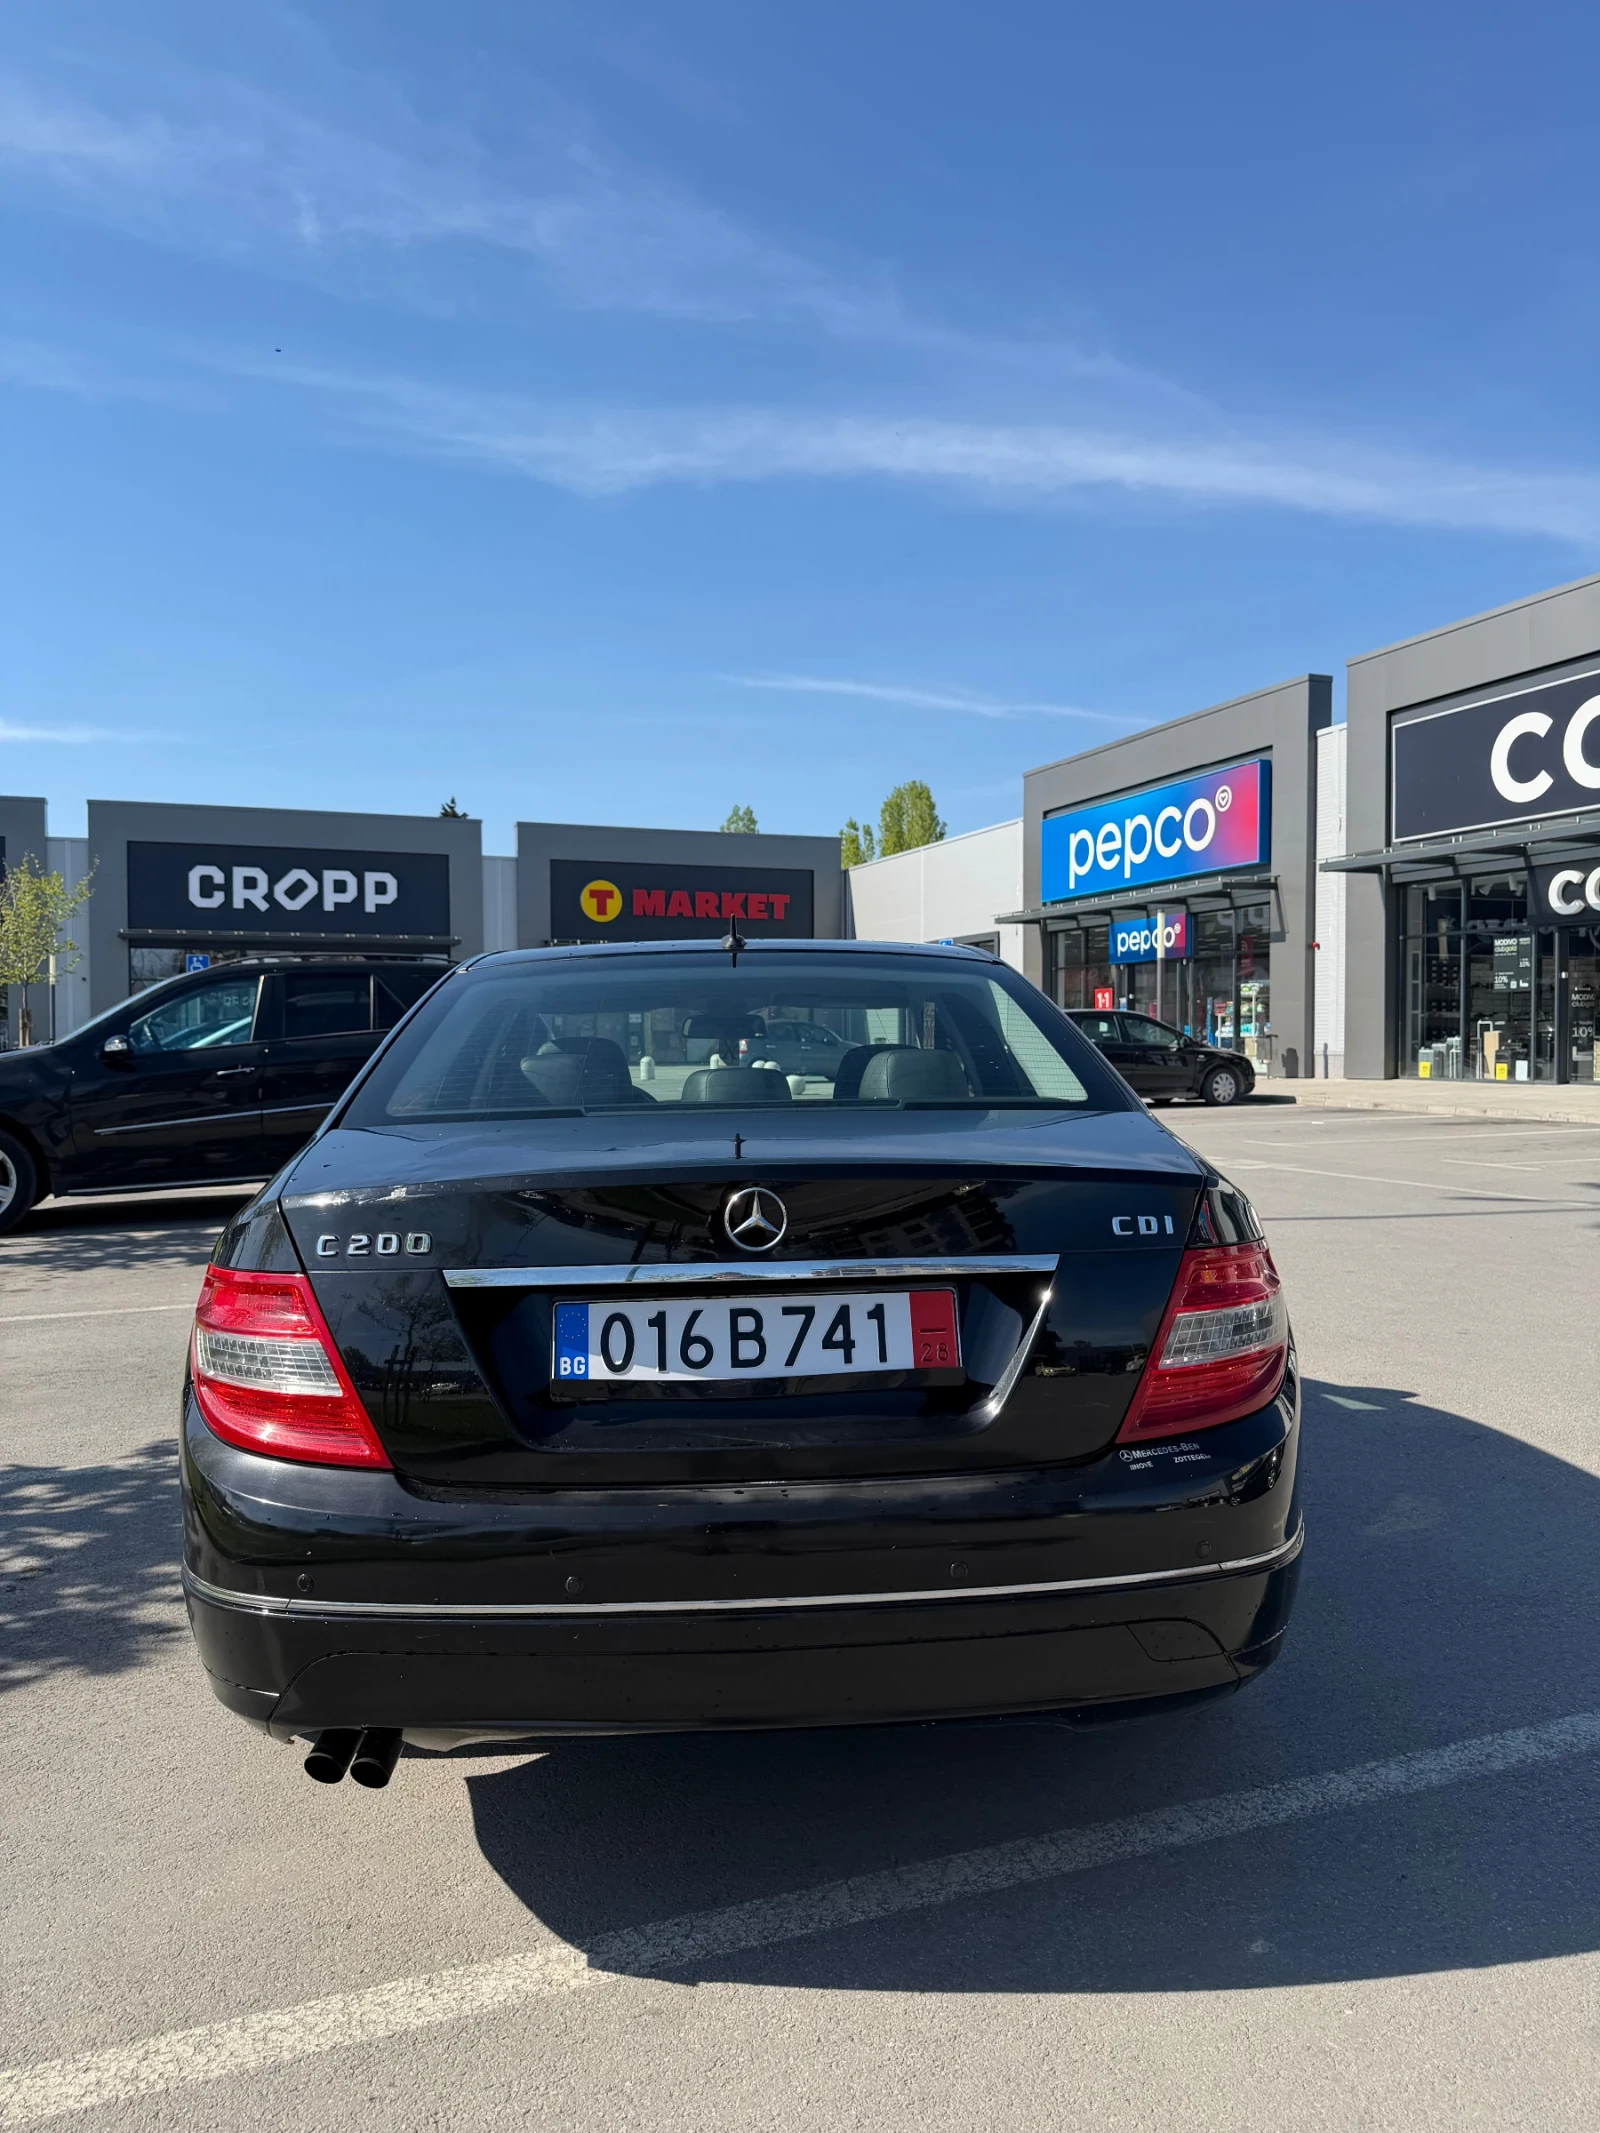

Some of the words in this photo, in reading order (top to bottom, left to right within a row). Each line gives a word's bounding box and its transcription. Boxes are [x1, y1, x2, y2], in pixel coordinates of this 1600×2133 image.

[1069, 798, 1216, 889] pepco
[188, 865, 398, 913] CROPP
[589, 889, 614, 916] T
[633, 889, 790, 920] MARKET
[1111, 1215, 1174, 1236] CDI
[317, 1234, 339, 1256] C
[347, 1232, 432, 1256] 200
[600, 1303, 888, 1375] 016B741
[921, 1342, 949, 1362] 28
[560, 1356, 586, 1375] BG
